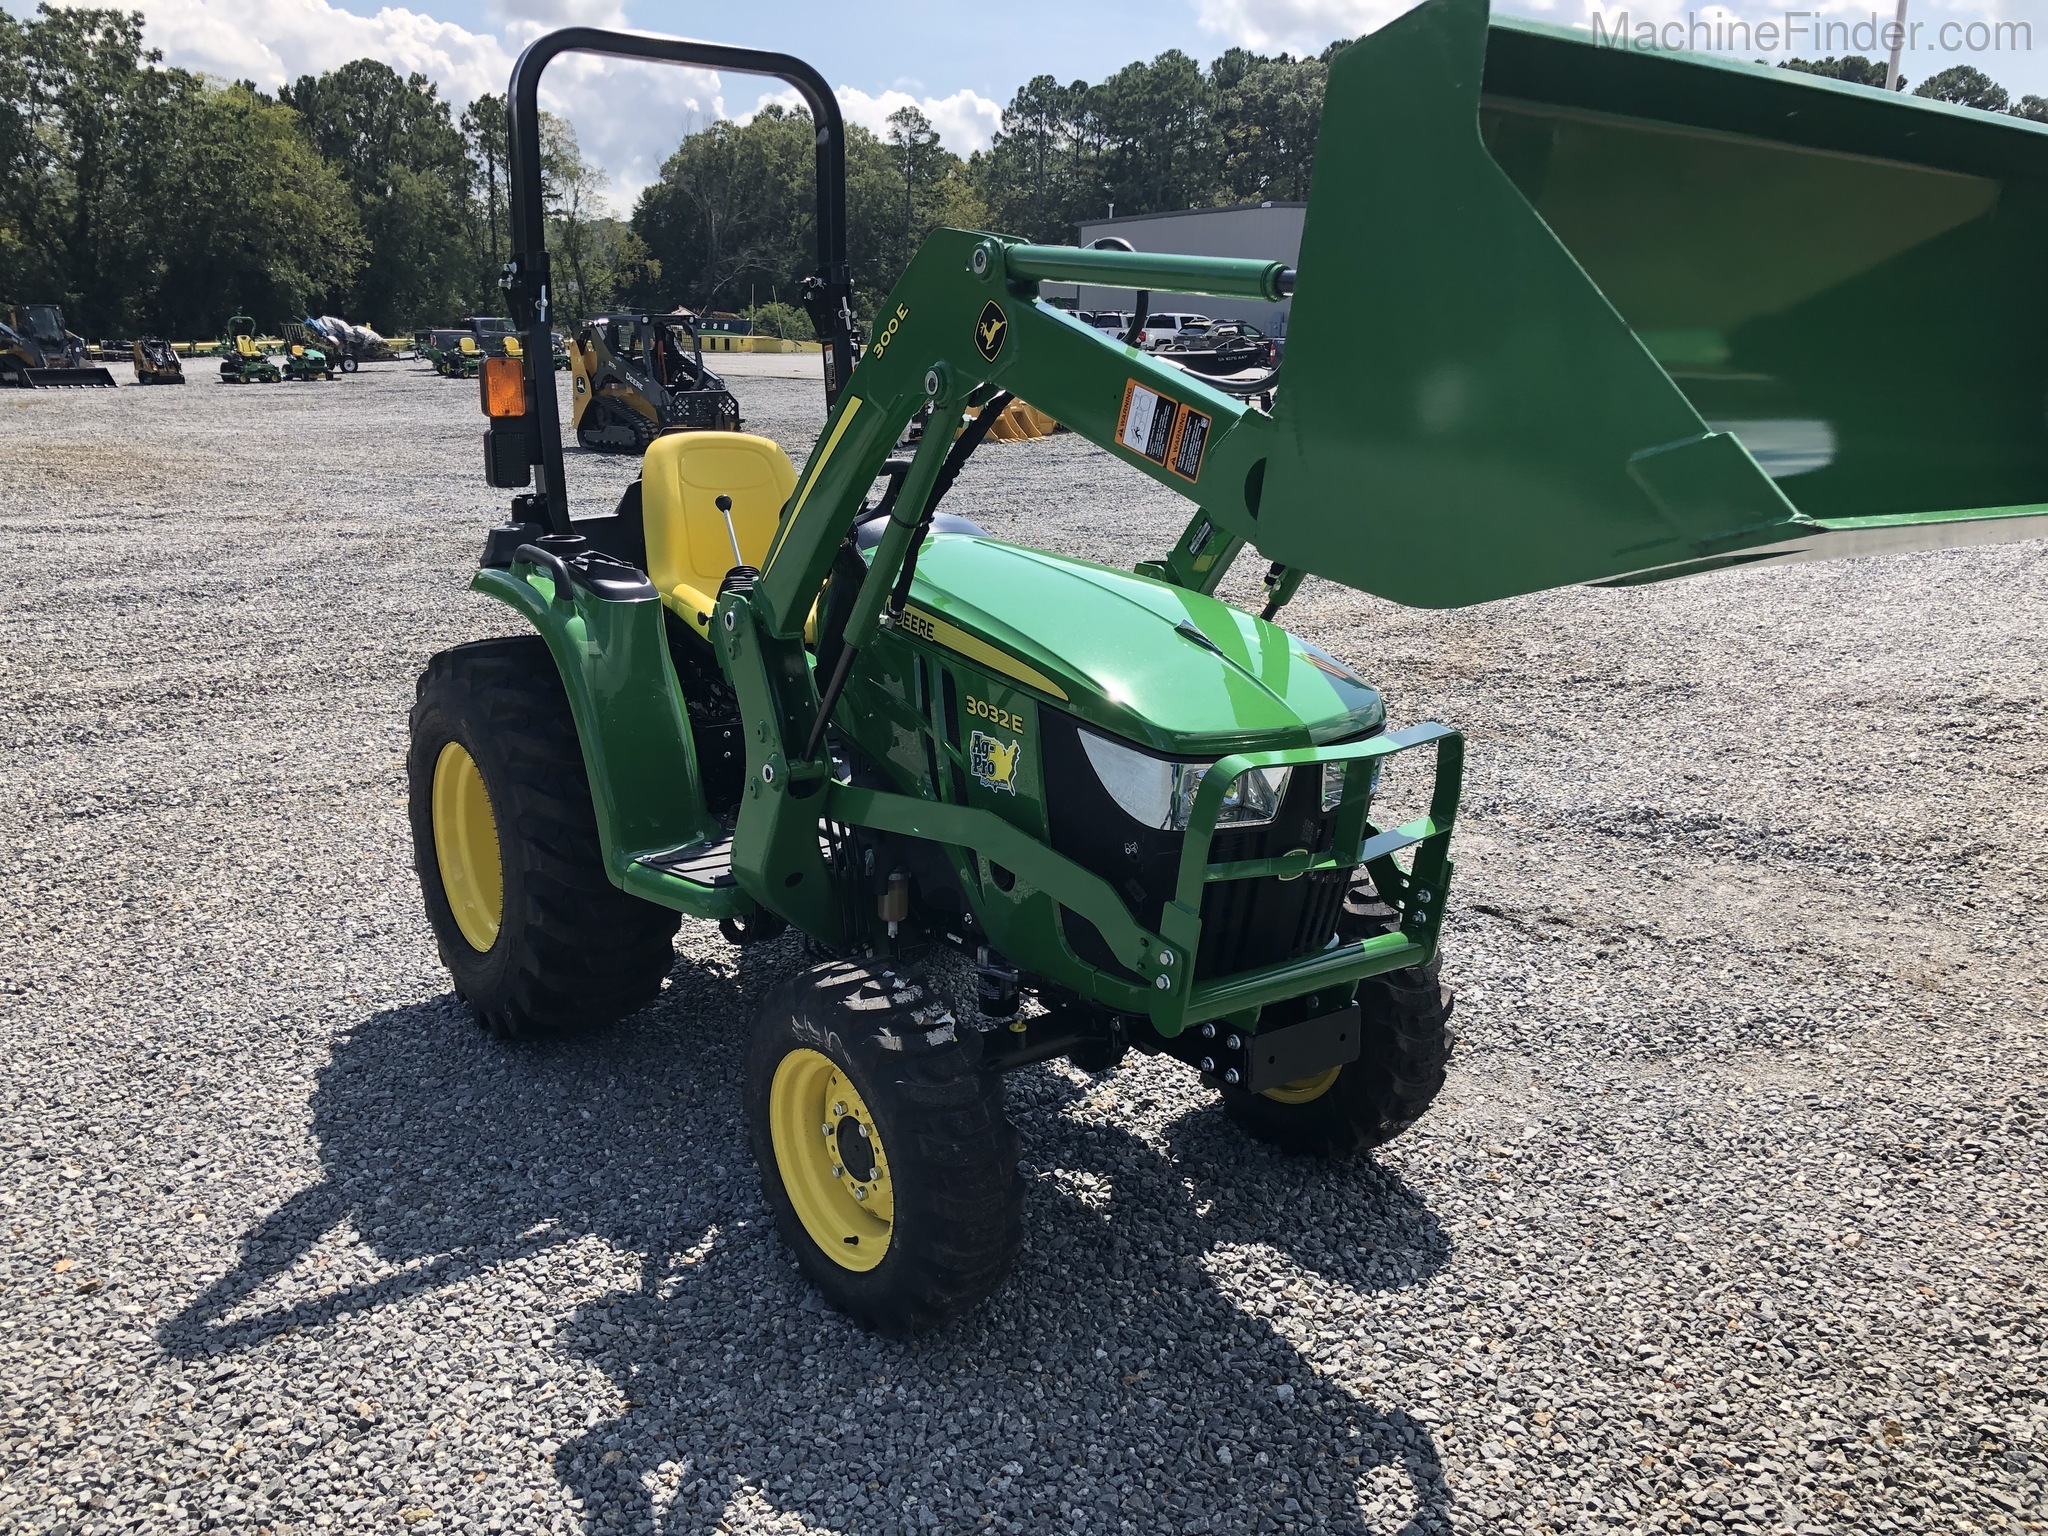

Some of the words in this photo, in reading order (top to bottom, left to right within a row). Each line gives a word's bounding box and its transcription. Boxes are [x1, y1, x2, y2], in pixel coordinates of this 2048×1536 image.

[625, 371, 644, 392] DEERE
[1119, 387, 1133, 428] WARNING
[1172, 412, 1187, 453] WARNING
[973, 753, 997, 776] Pro
